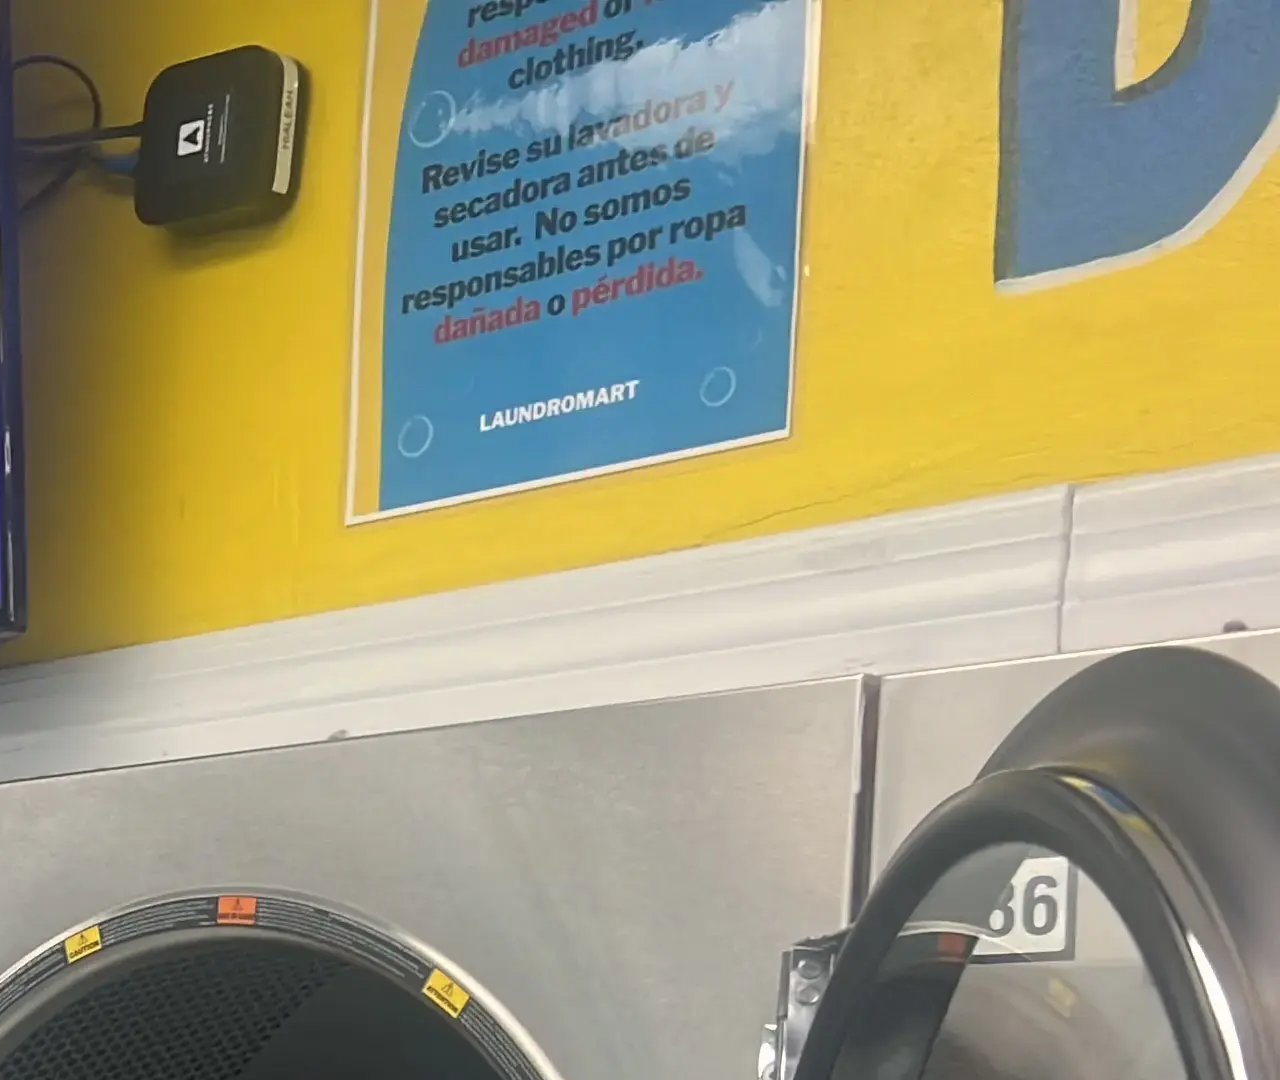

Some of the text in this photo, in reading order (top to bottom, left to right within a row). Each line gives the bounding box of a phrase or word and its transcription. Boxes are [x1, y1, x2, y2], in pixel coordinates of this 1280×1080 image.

[458, 0, 598, 68] damaged
[468, 0, 550, 27] resp
[508, 29, 644, 90] clothing.
[422, 80, 735, 194] Revise su lavadora y
[433, 126, 717, 229] secadora antes de
[401, 203, 747, 314] responsables por ropa
[451, 178, 691, 262] usar. No somos
[433, 256, 704, 344] dañada o pérdida.
[479, 379, 640, 432] LAUNDROMART
